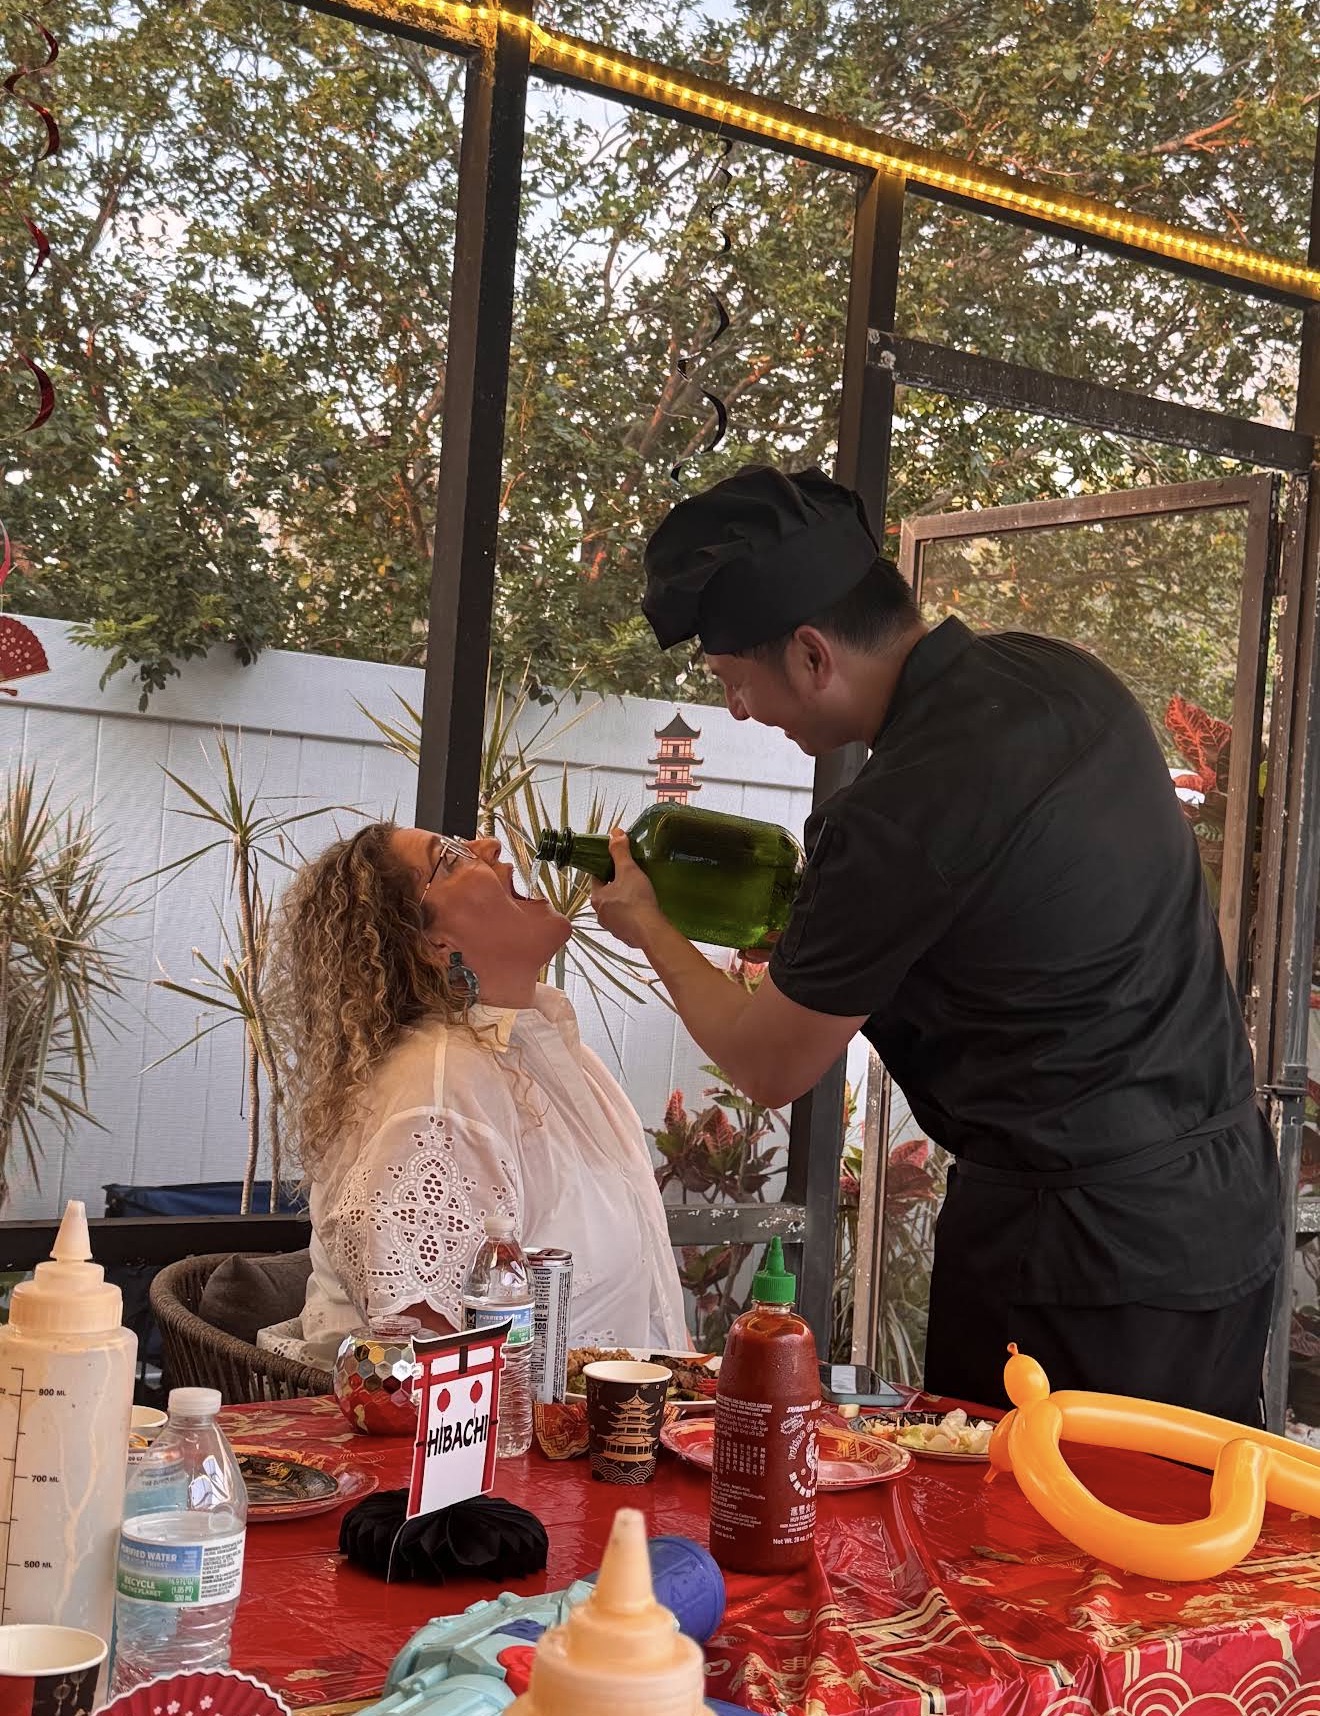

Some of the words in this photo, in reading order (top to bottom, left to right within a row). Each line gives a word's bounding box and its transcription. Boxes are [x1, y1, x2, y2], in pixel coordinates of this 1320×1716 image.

[427, 1414, 488, 1457] HIBACHI
[31, 1475, 48, 1483] 700
[147, 1551, 178, 1562] WATER
[24, 1560, 41, 1569] 500
